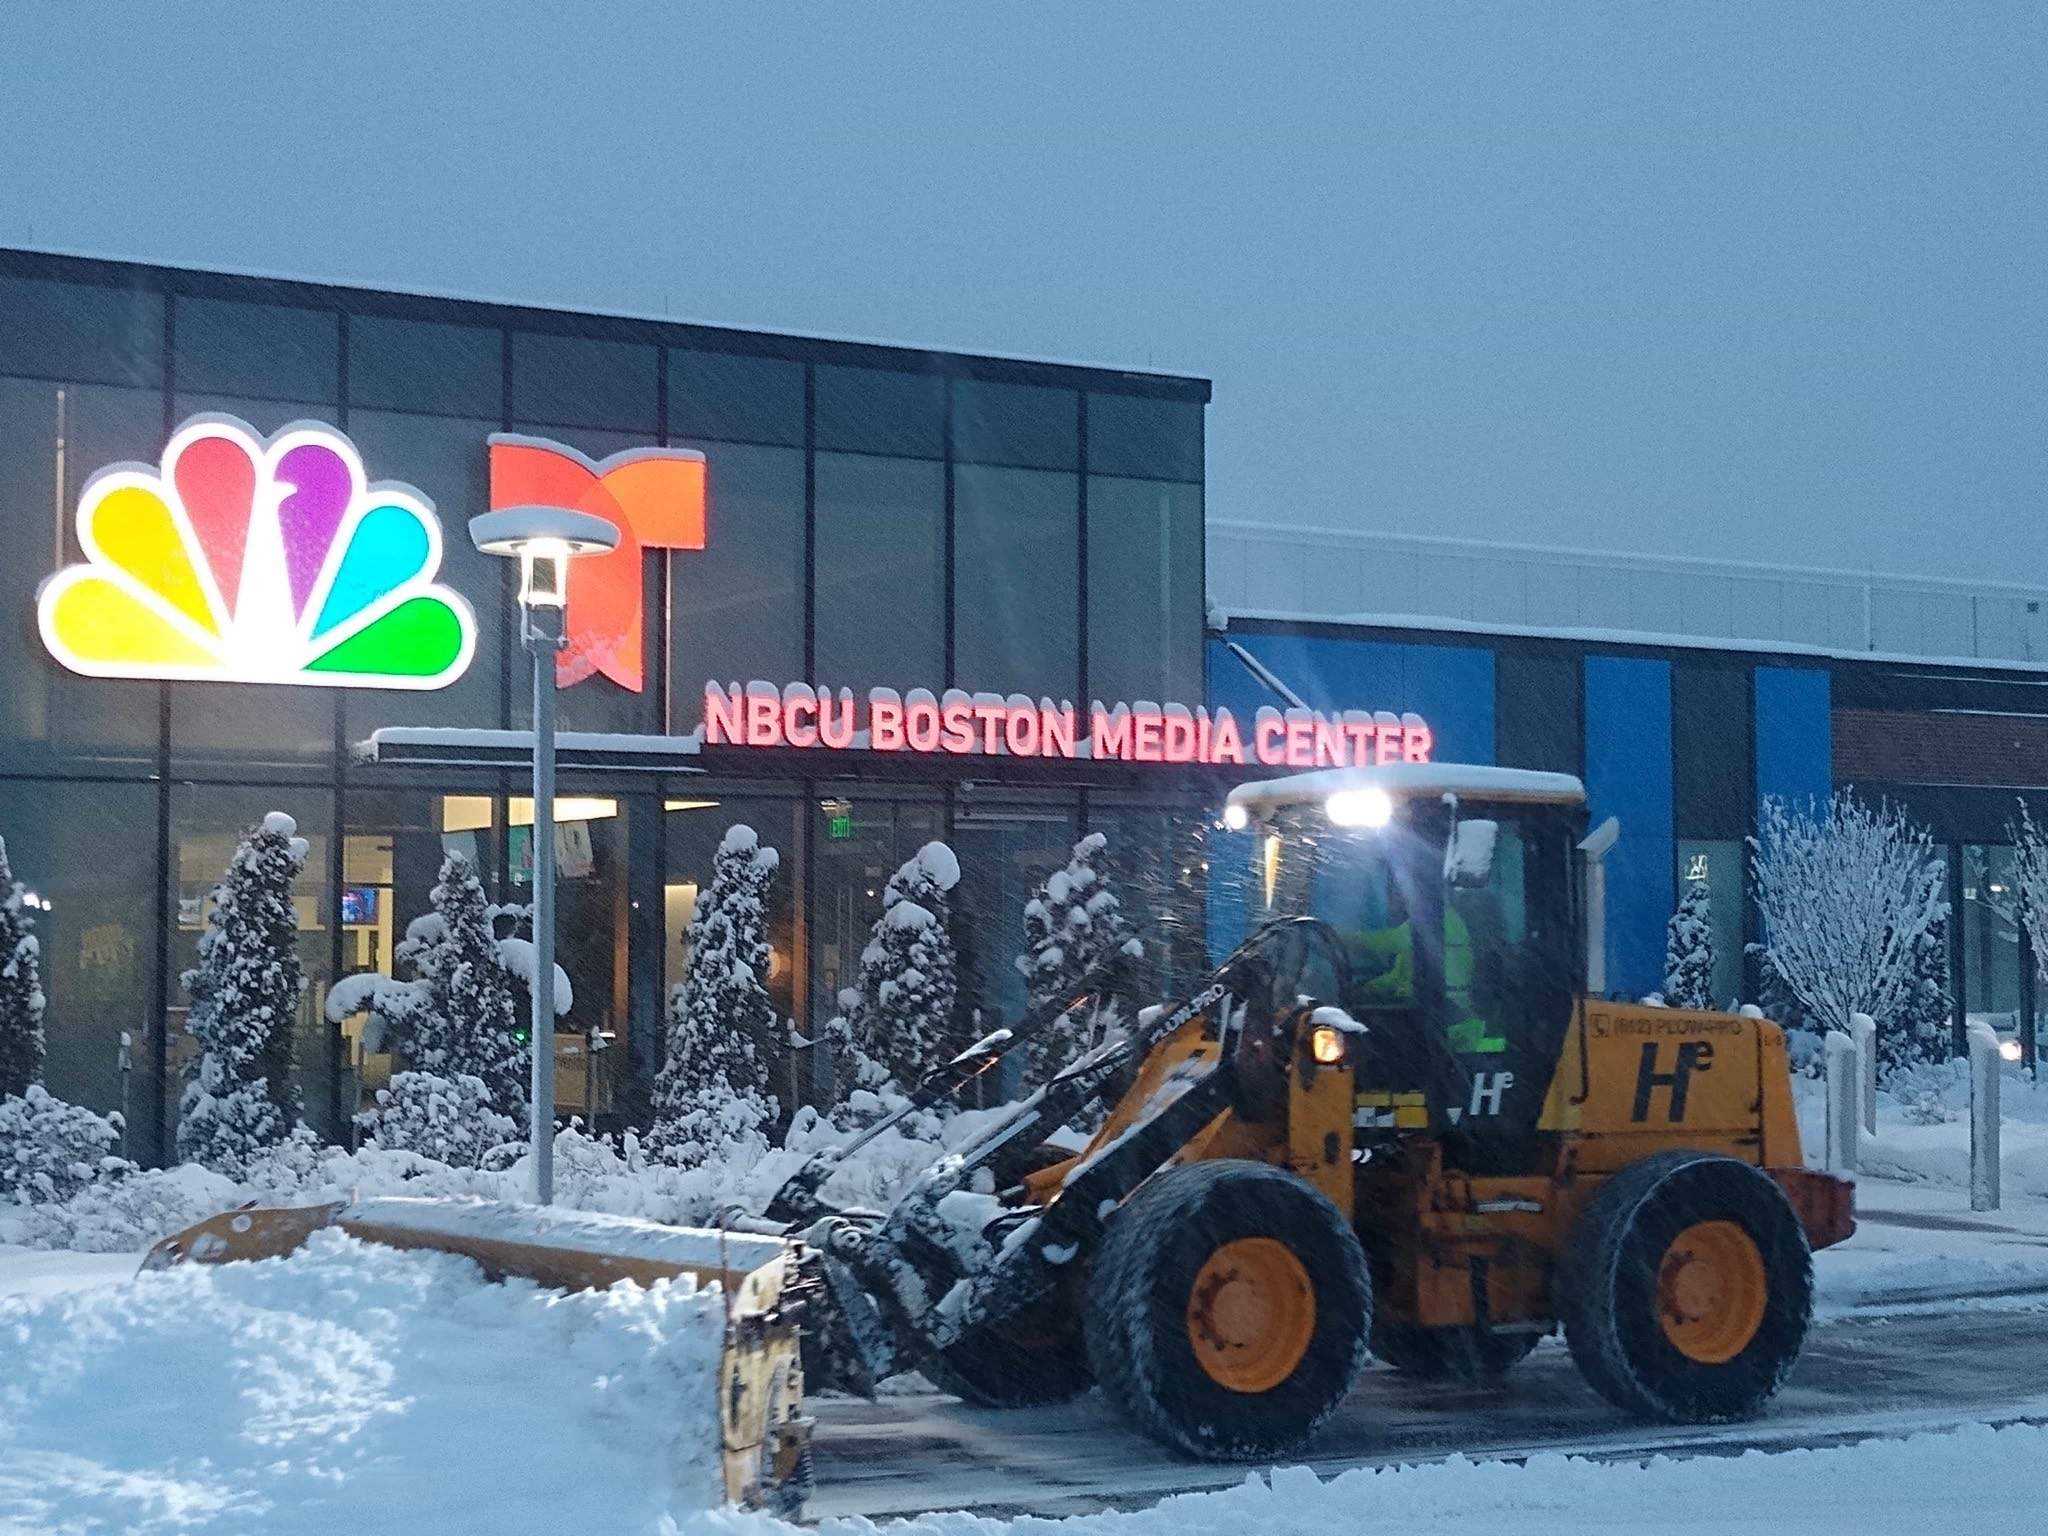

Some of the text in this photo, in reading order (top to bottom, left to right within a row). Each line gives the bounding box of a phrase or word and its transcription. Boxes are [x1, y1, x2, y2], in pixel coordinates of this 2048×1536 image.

[706, 689, 1432, 767] NBCU BOSTON MEDIA CENTER
